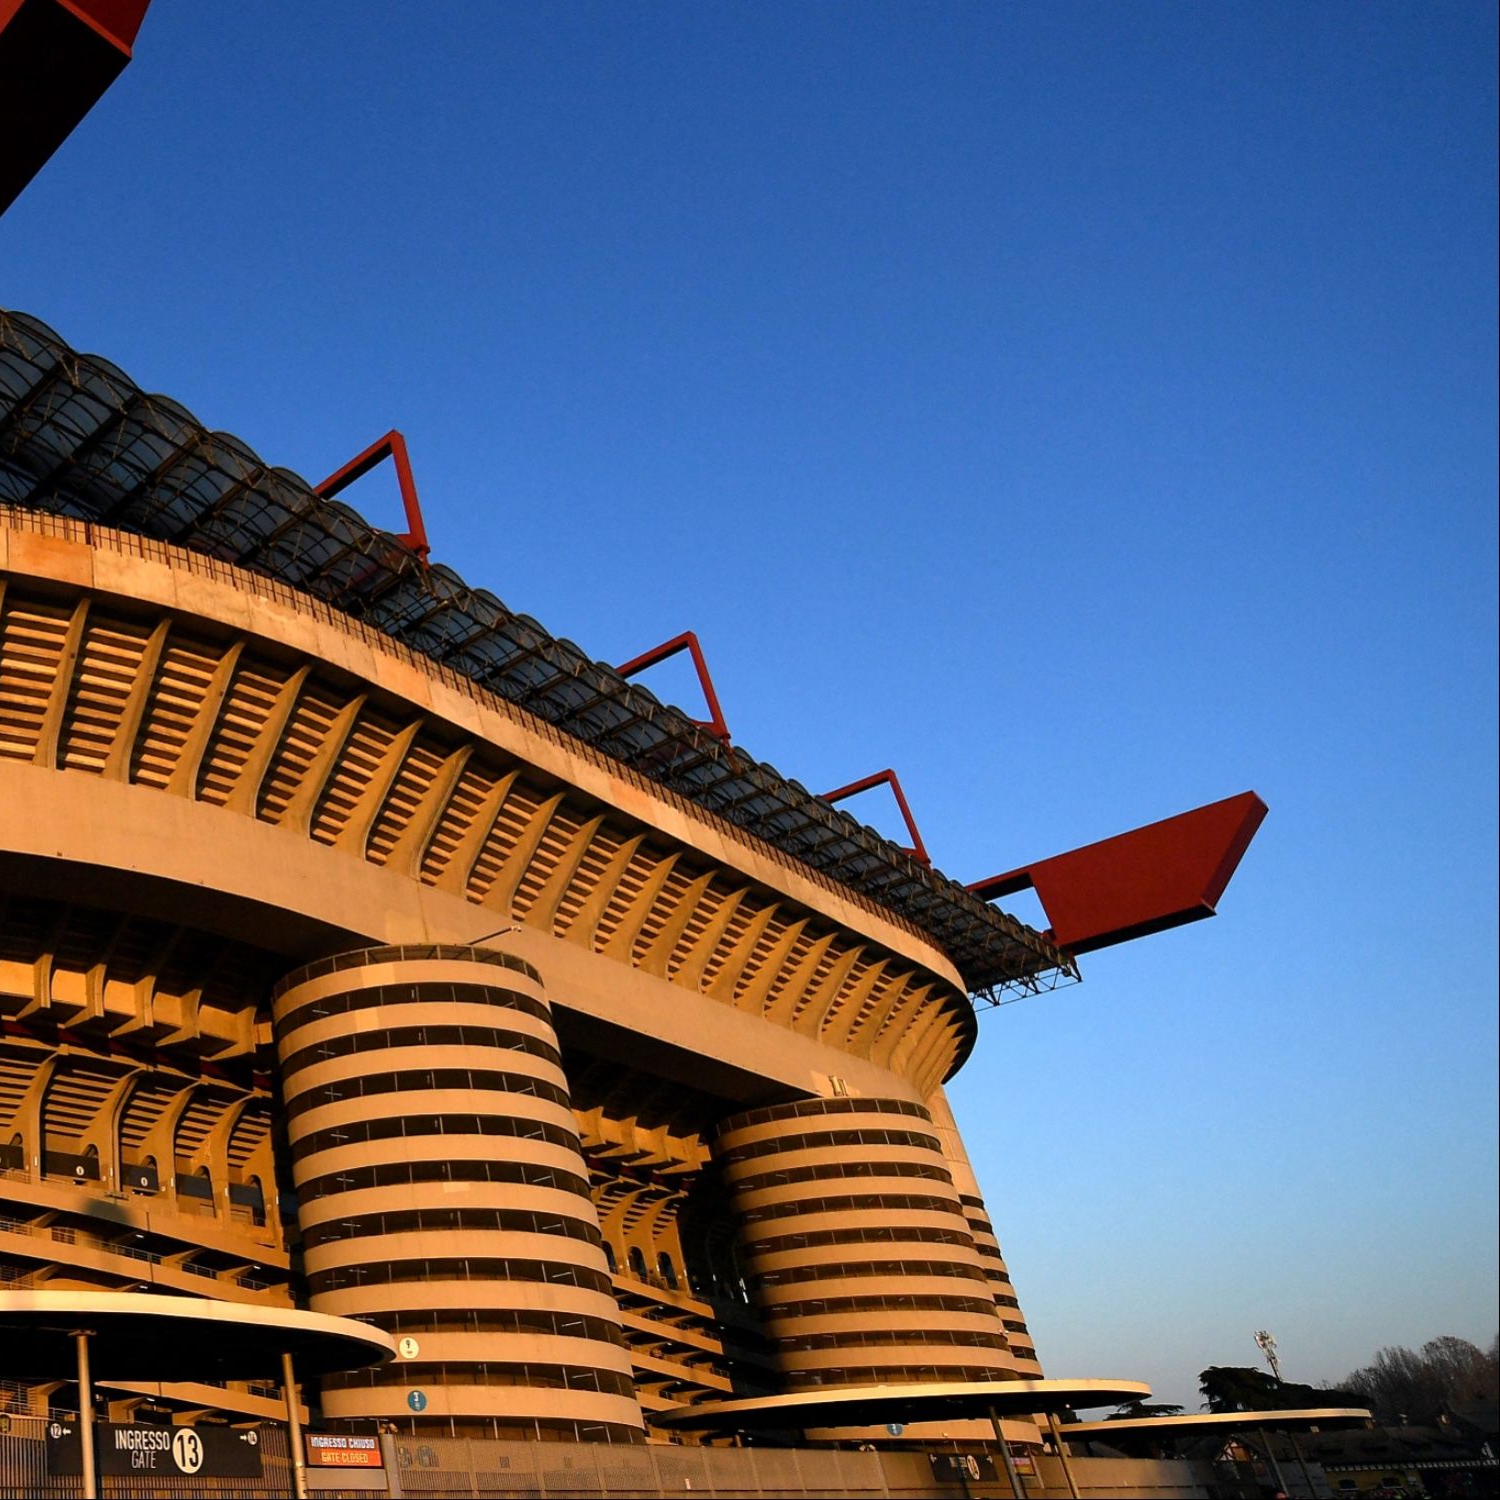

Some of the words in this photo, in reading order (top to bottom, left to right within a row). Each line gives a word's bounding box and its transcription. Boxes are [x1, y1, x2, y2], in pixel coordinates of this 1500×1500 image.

[51, 1424, 61, 1438] 12
[115, 1429, 170, 1450] INGRESSO
[311, 1436, 347, 1448] INGRESSO
[348, 1438, 375, 1449] CHIUSO
[176, 1434, 199, 1468] 13
[321, 1452, 340, 1463] GATE
[341, 1453, 369, 1464] CLOSED
[131, 1450, 157, 1469] GATE
